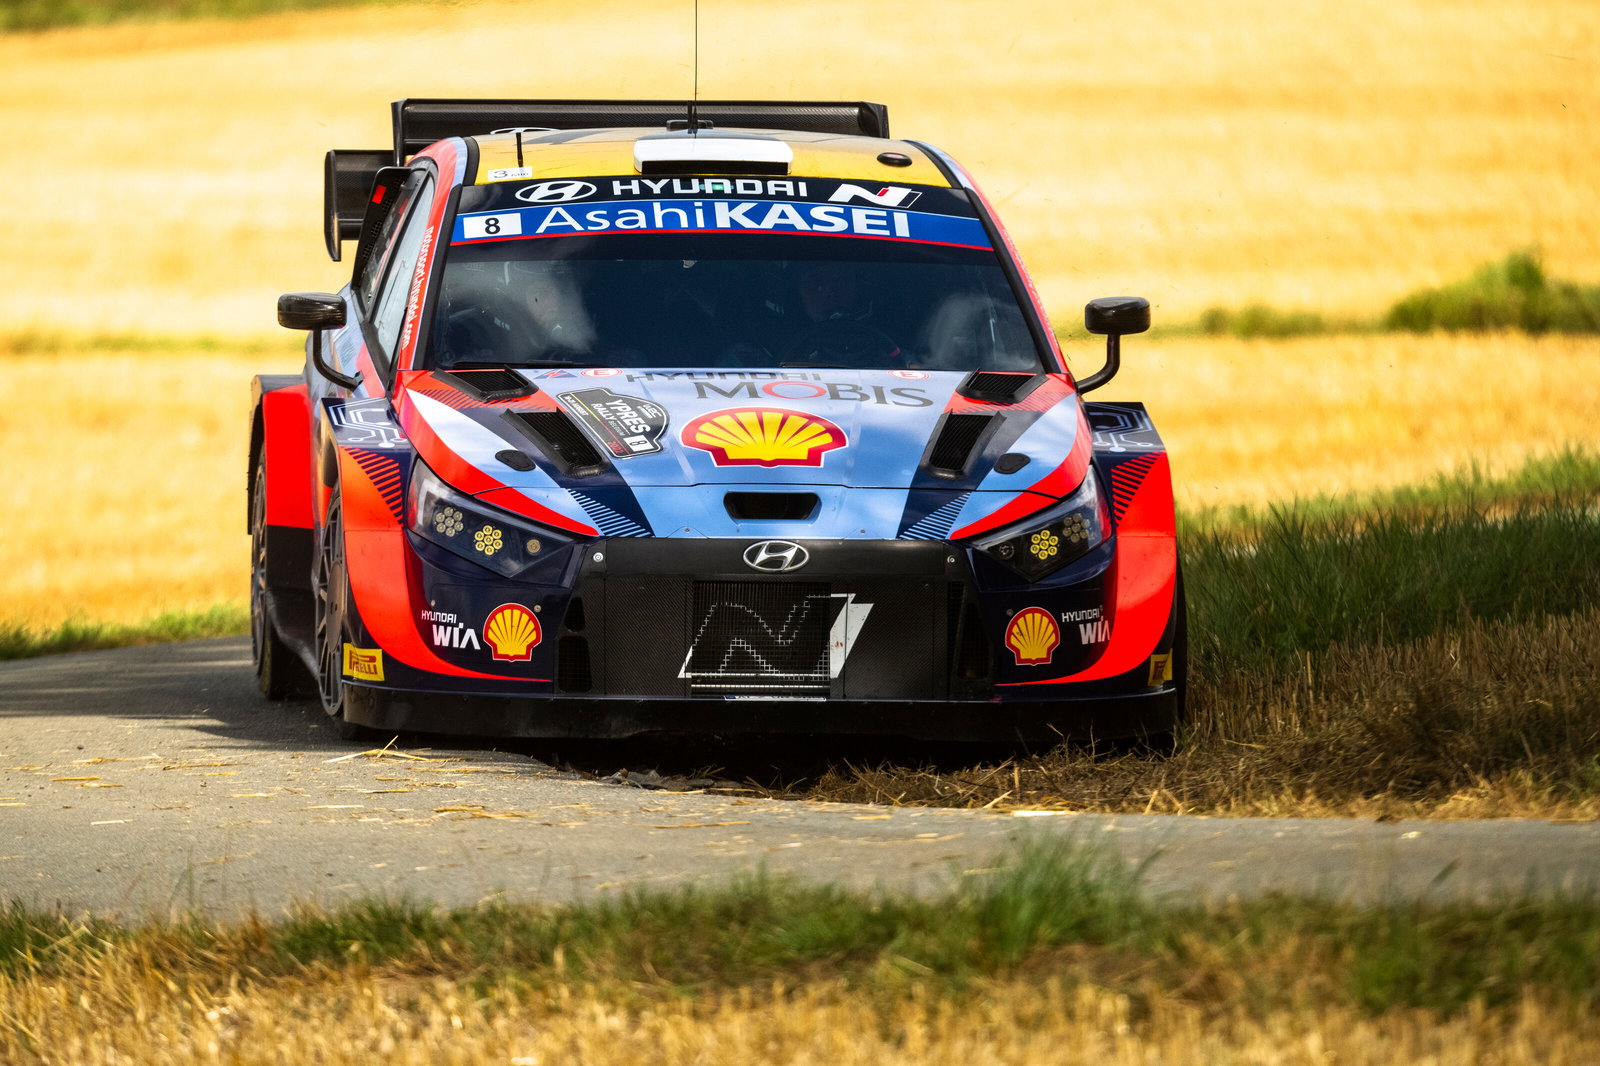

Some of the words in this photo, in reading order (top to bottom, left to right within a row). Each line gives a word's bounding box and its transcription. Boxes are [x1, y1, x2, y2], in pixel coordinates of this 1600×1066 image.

[612, 178, 808, 197] HYUNDAI
[484, 217, 501, 235] 8
[694, 381, 934, 408] MOBIS
[590, 403, 617, 420] RALLY
[605, 399, 651, 434] YPRES
[421, 610, 457, 624] HYUNDAI
[1061, 607, 1101, 623] HYUNDAI
[432, 622, 481, 650] WIA
